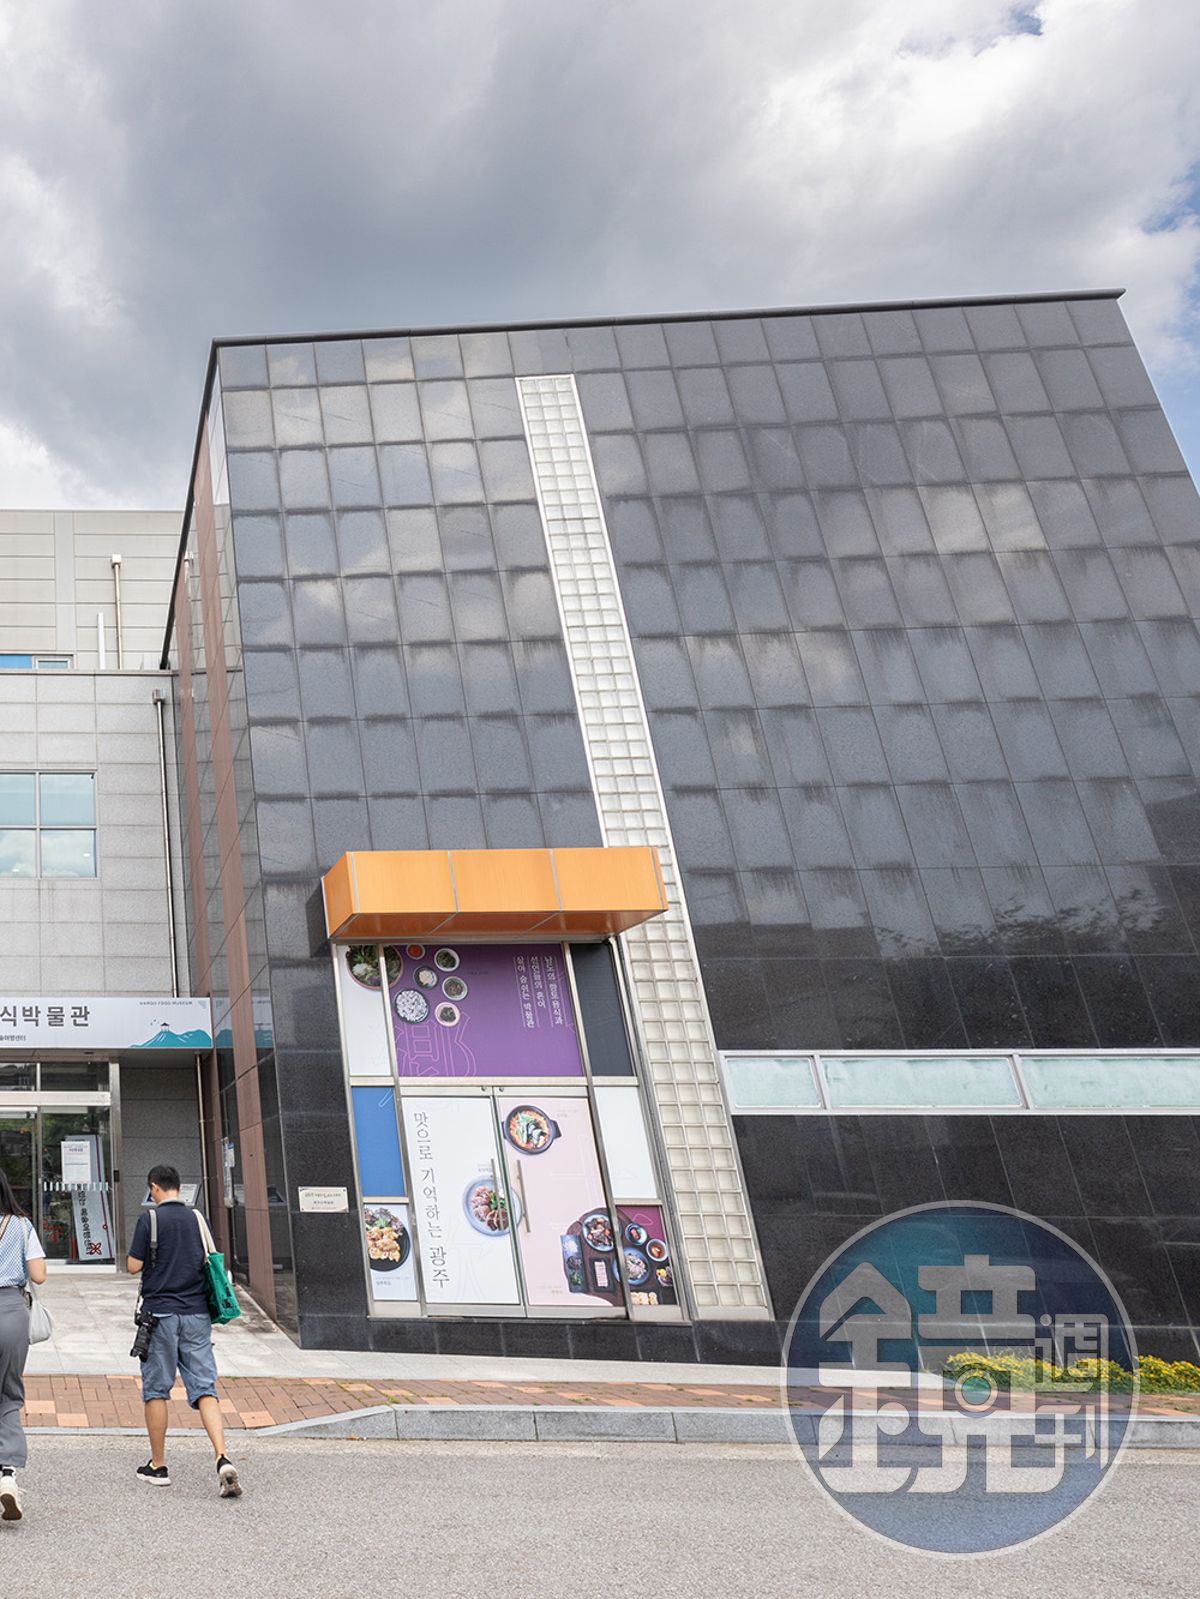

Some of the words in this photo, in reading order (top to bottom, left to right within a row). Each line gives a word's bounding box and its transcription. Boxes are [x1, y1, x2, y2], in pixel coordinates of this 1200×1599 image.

[523, 1003, 535, 1028] 박물관
[413, 1111, 433, 1161] 맛으로
[421, 1167, 442, 1239] 기억하는
[429, 1246, 450, 1289] 광주
